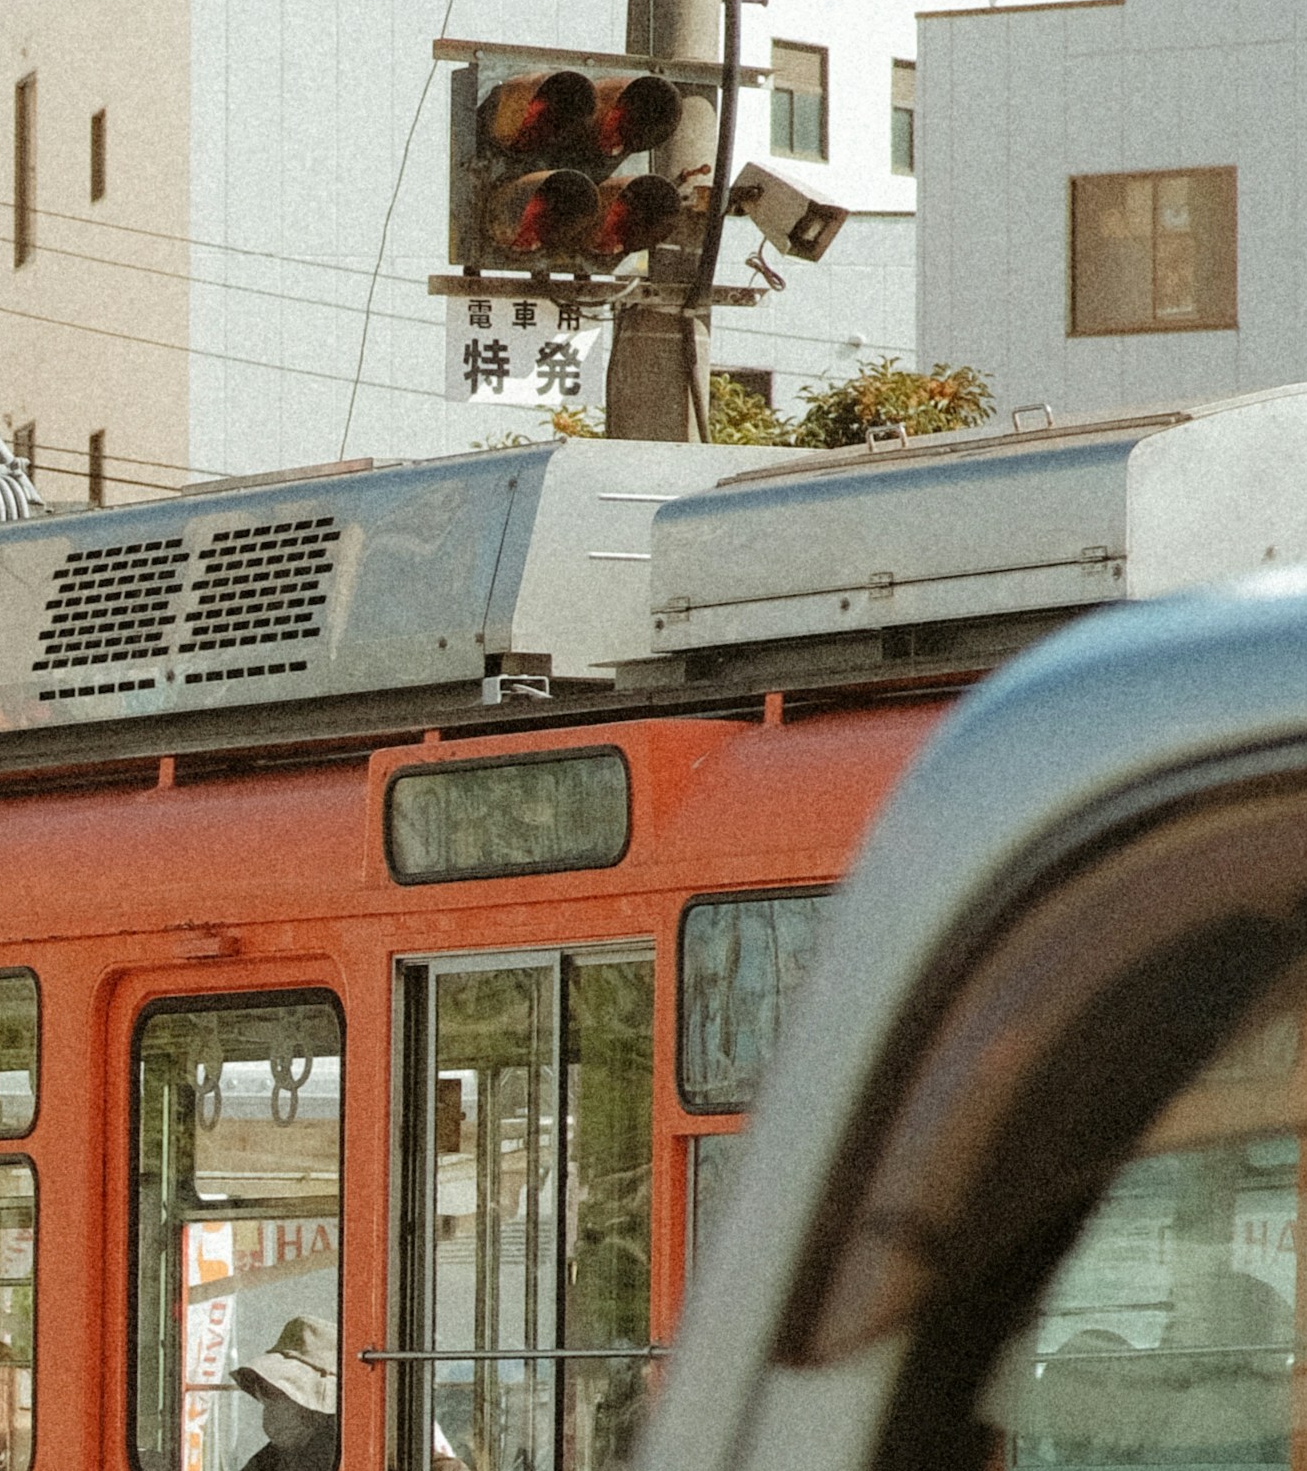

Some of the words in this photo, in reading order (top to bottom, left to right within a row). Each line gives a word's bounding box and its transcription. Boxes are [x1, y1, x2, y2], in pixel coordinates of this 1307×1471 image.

[467, 298, 582, 332] 電車用
[463, 337, 583, 397] 特発
